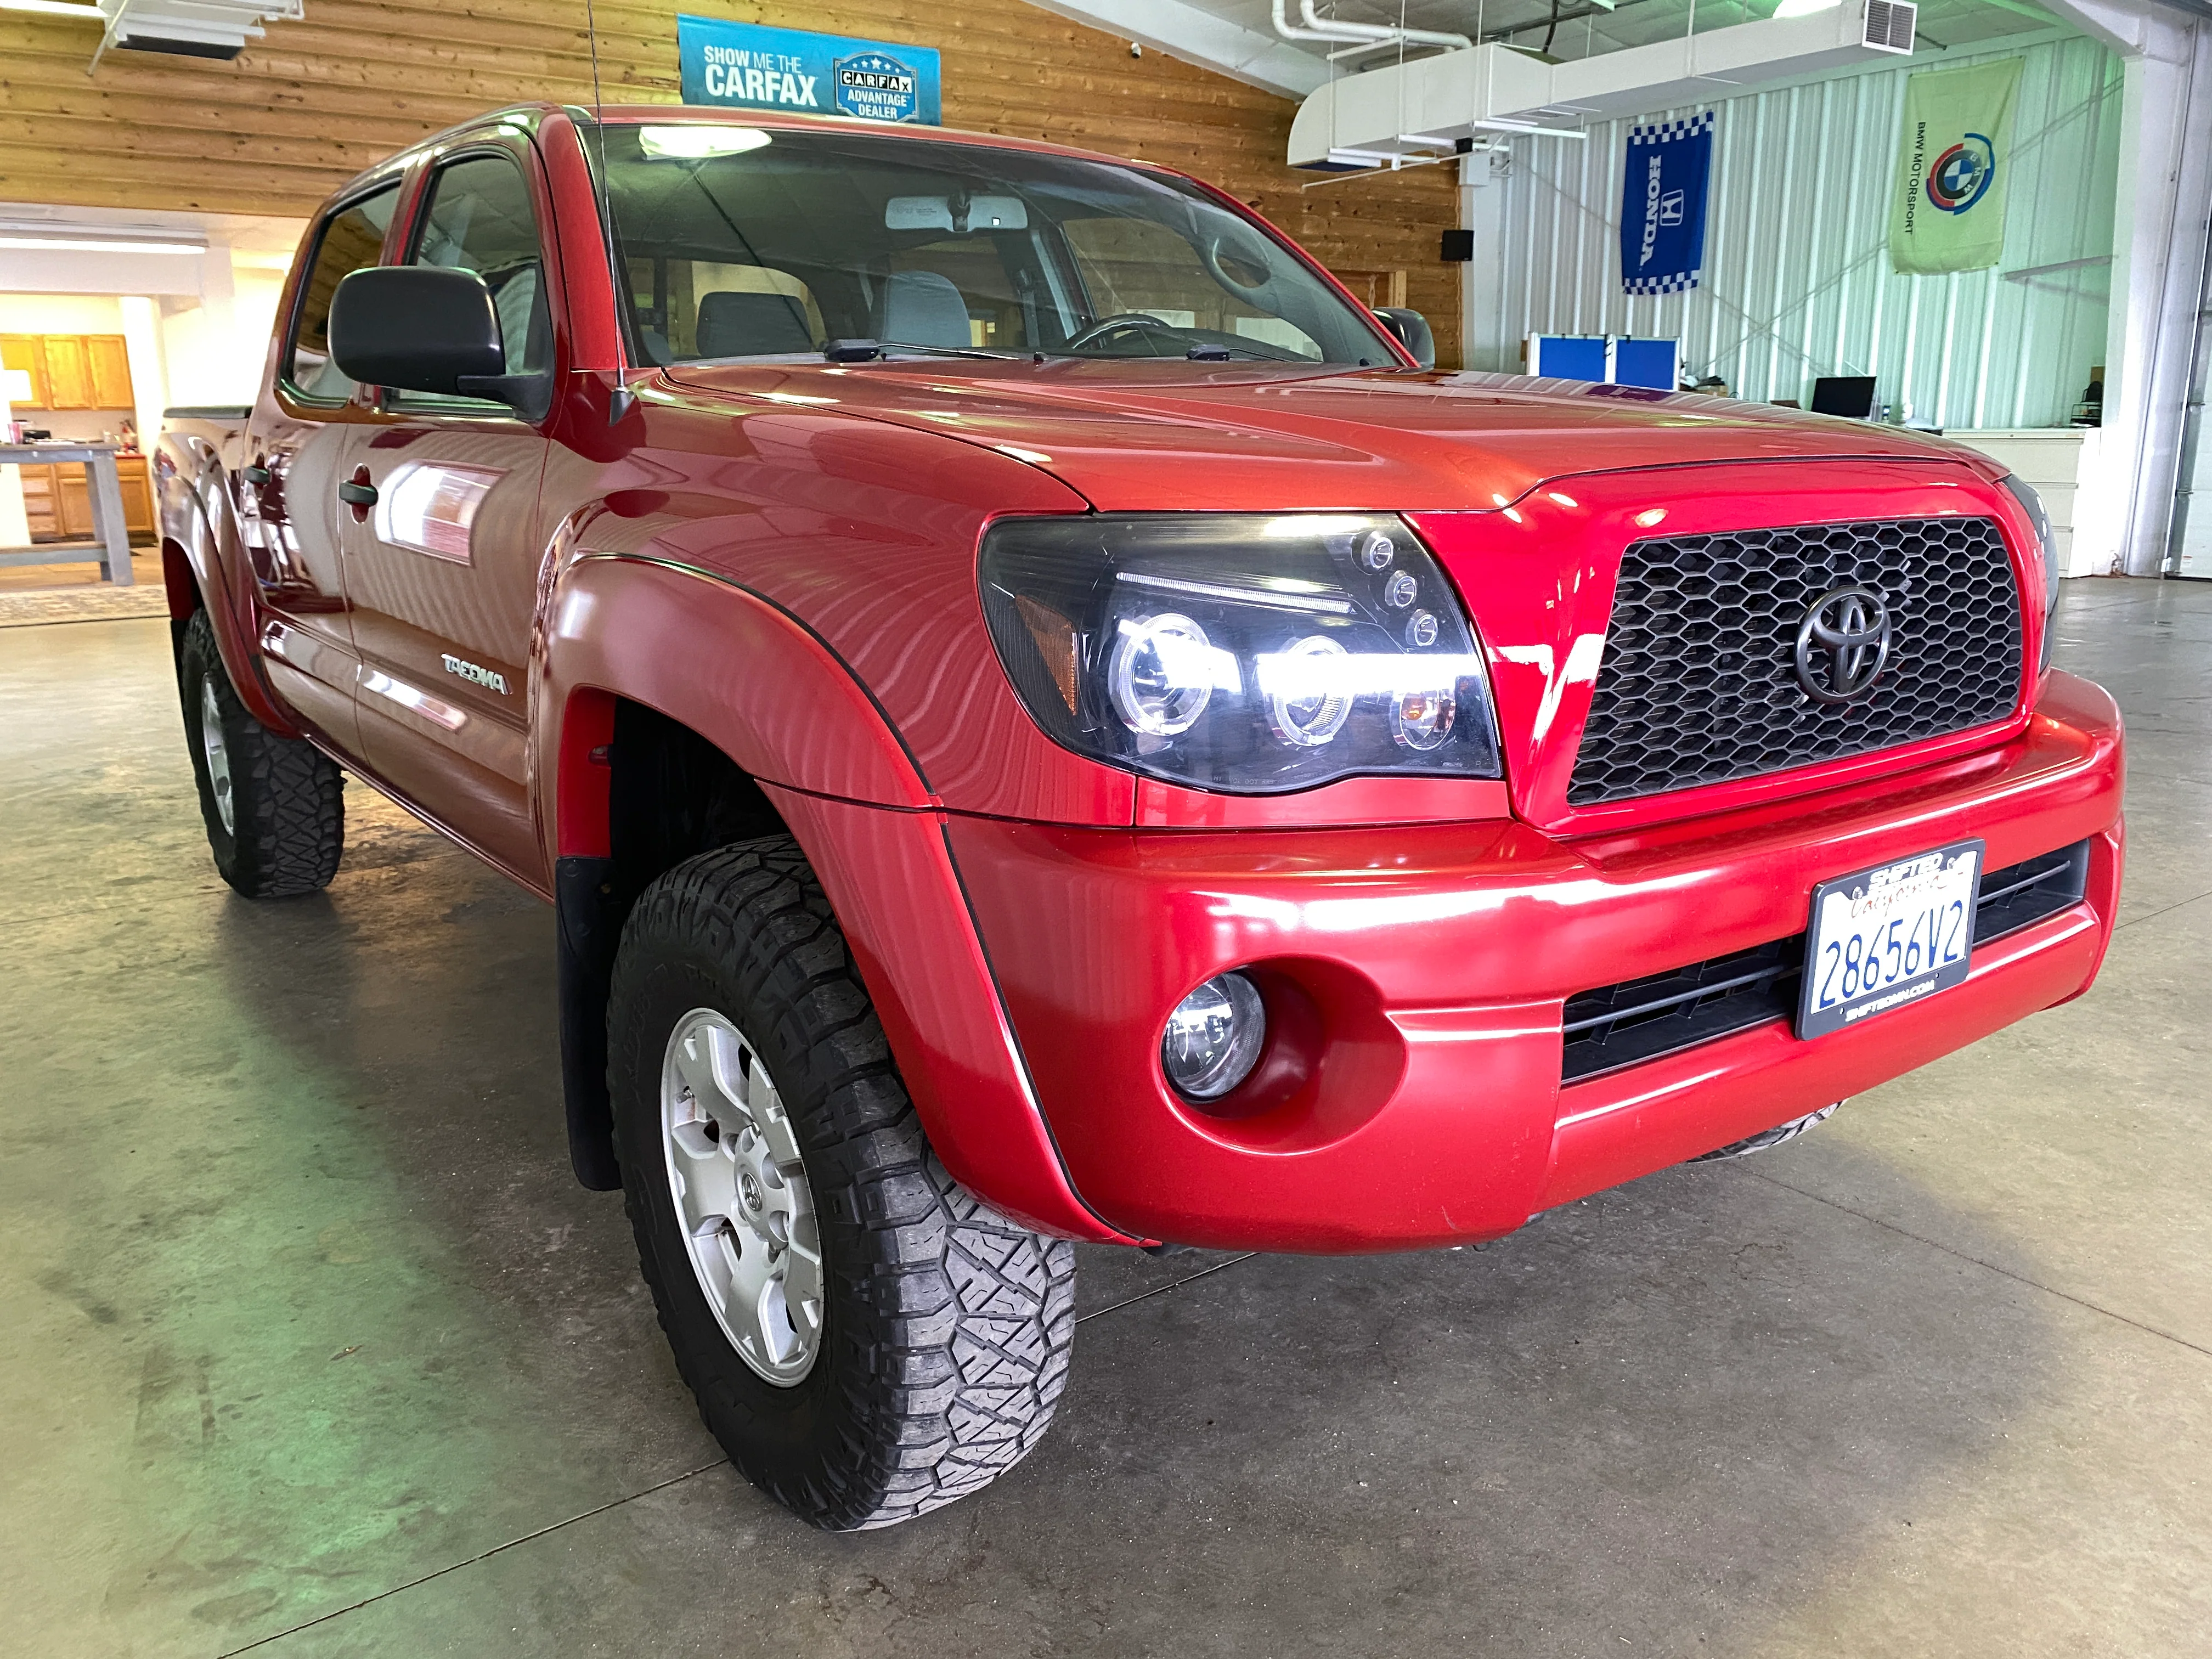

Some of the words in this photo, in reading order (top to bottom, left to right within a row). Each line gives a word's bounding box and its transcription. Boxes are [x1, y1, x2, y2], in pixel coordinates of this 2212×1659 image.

[704, 46, 749, 67] SHOW
[753, 52, 775, 70] ME
[777, 55, 802, 74] THE
[706, 64, 818, 106] CARFAX
[842, 71, 910, 92] CARFAX
[848, 89, 907, 107] ADVANTAGE
[858, 104, 897, 119] DEALER
[1915, 122, 1926, 150] BMW
[1964, 153, 1982, 194] BMW
[1640, 155, 1661, 266] HONDA
[1905, 153, 1922, 235] MOTORSPORT
[441, 653, 511, 695] TACOMA
[1869, 853, 1943, 891] SHIFTED
[1819, 900, 1962, 1009] 28656V2
